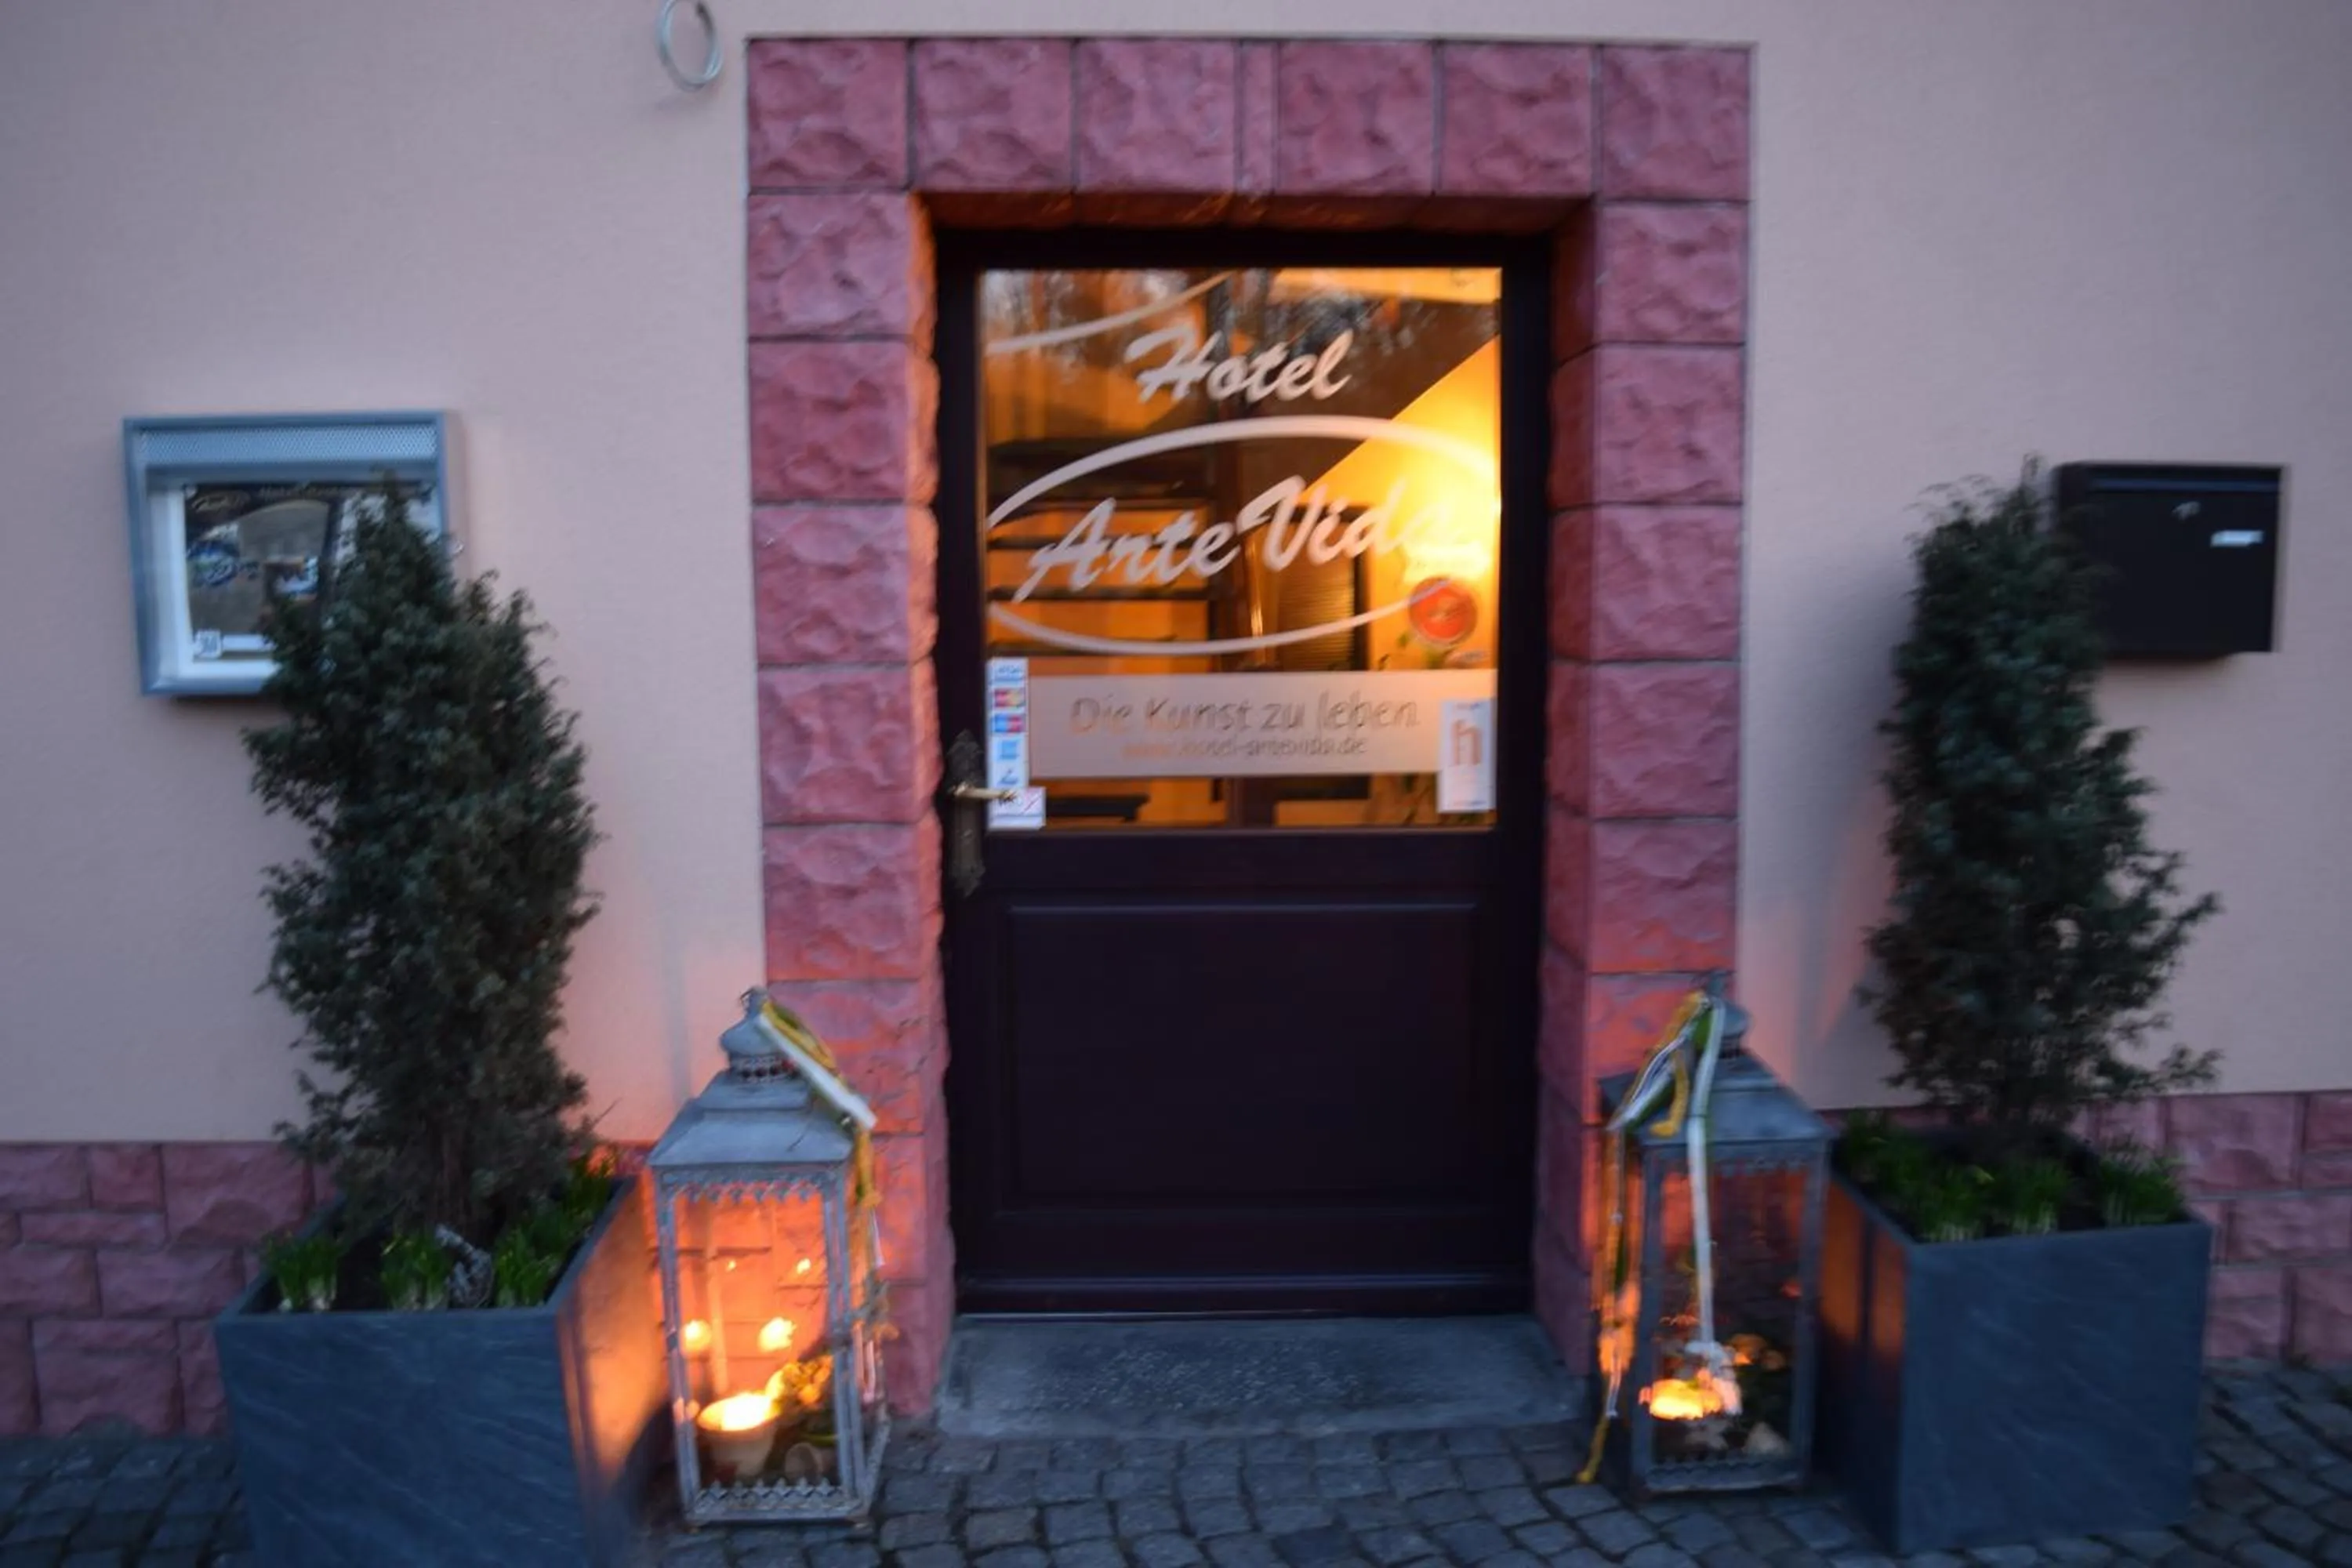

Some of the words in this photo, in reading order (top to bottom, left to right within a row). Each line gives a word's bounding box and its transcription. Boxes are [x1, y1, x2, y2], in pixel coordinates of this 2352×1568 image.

[1125, 323, 1353, 404] Hotel
[1011, 496, 1241, 602] Arte
[1070, 692, 1133, 734] Die
[1144, 695, 1254, 732] Kunst
[1260, 701, 1306, 731] zu
